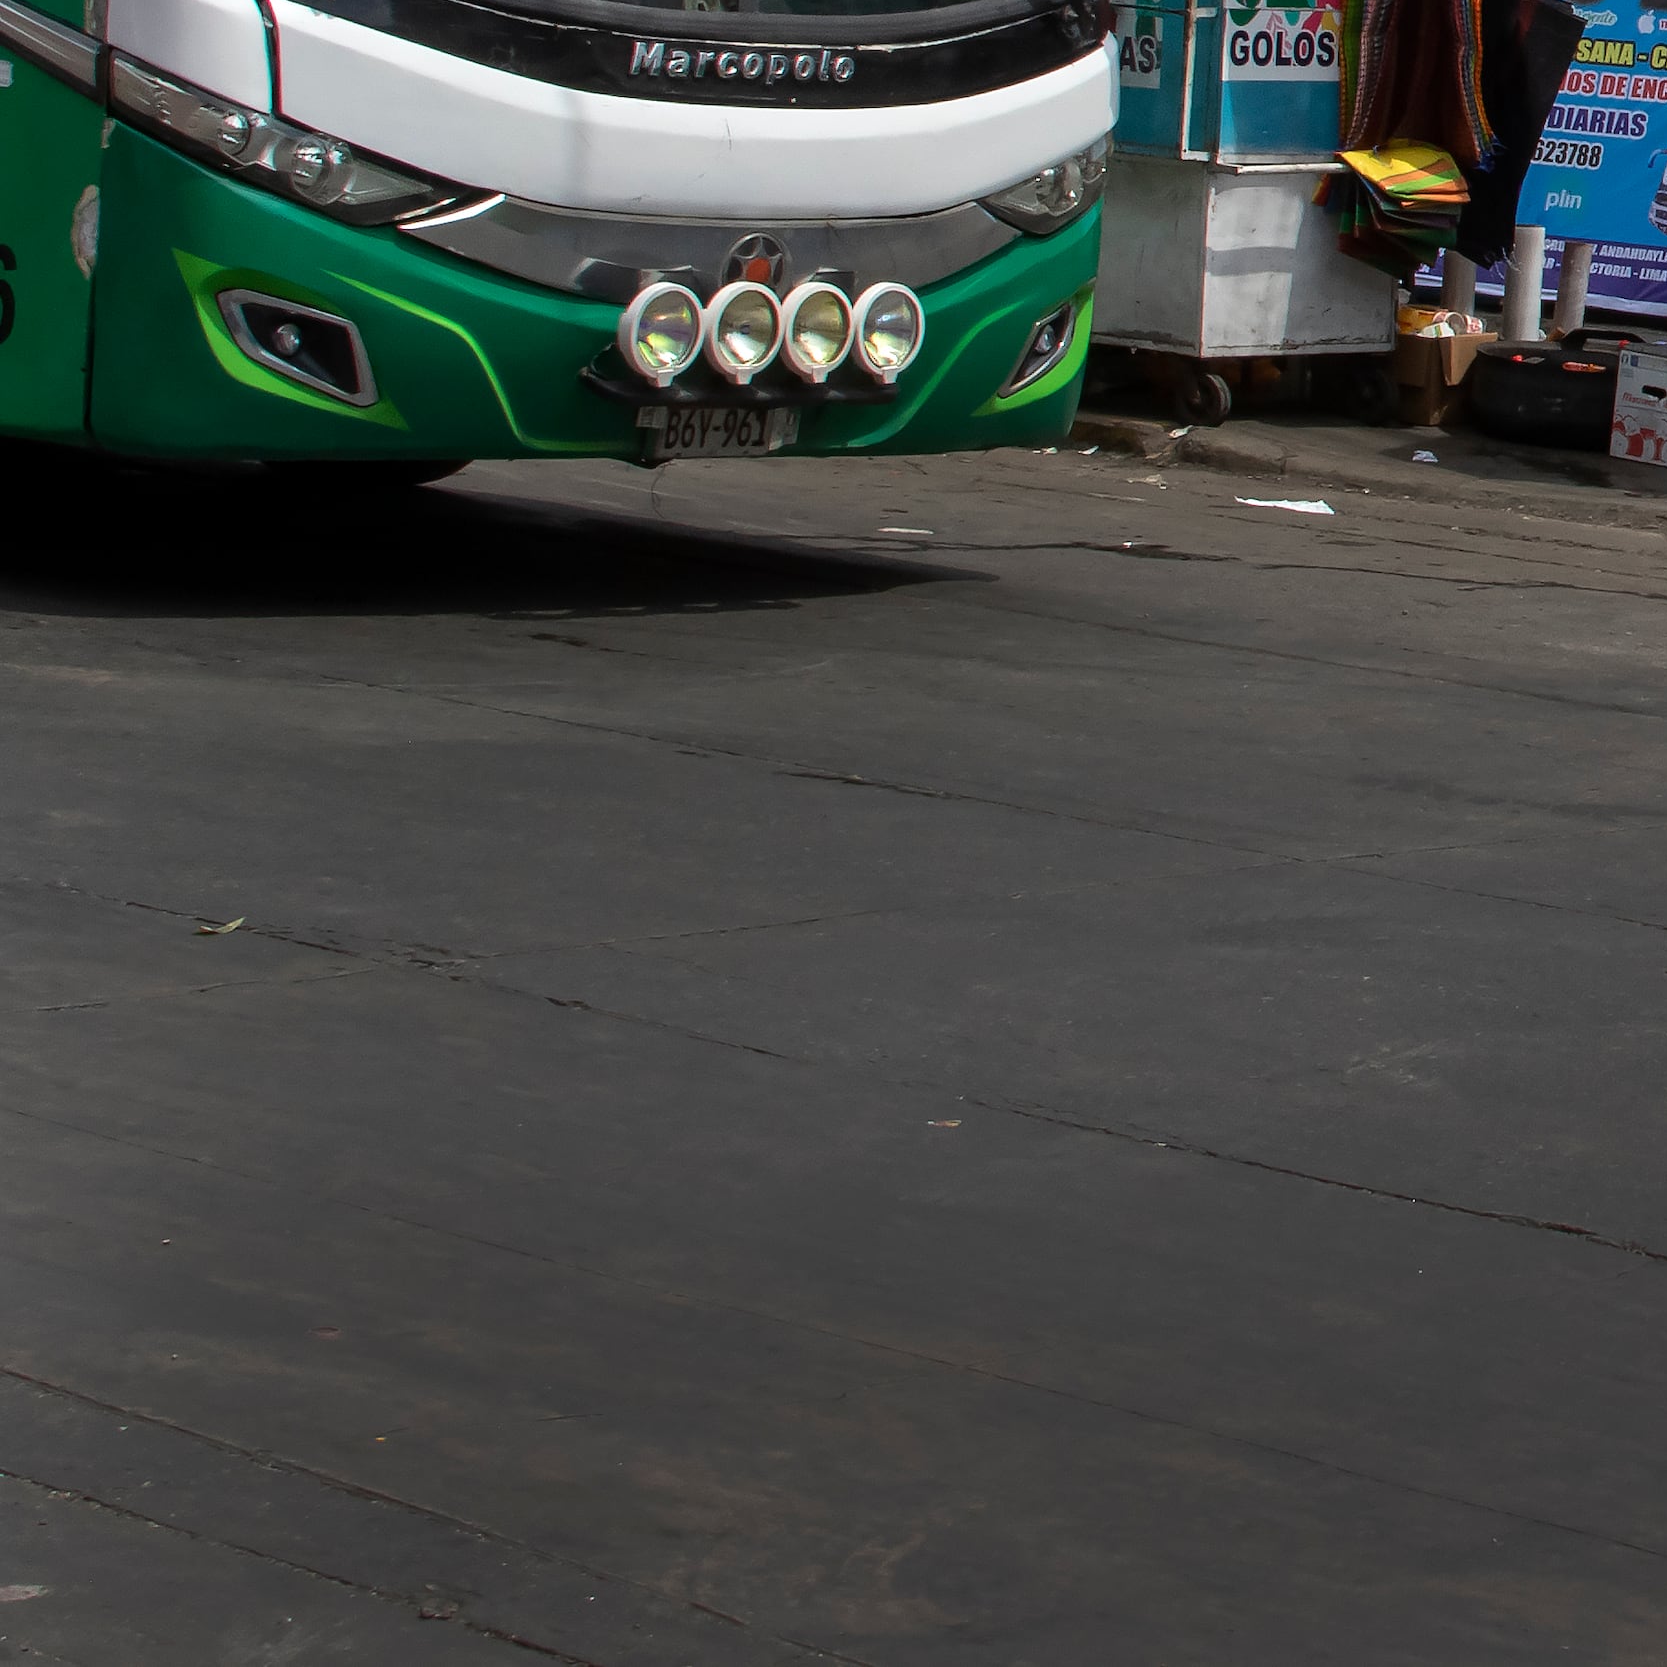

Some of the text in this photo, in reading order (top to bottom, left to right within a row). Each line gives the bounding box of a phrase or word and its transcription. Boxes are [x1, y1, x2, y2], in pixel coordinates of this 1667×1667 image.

[628, 39, 857, 86] Marcopolo
[1230, 30, 1340, 68] GOLOS
[1599, 74, 1629, 97] DE
[1548, 106, 1648, 137] DIARIAS
[1544, 189, 1583, 212] plin
